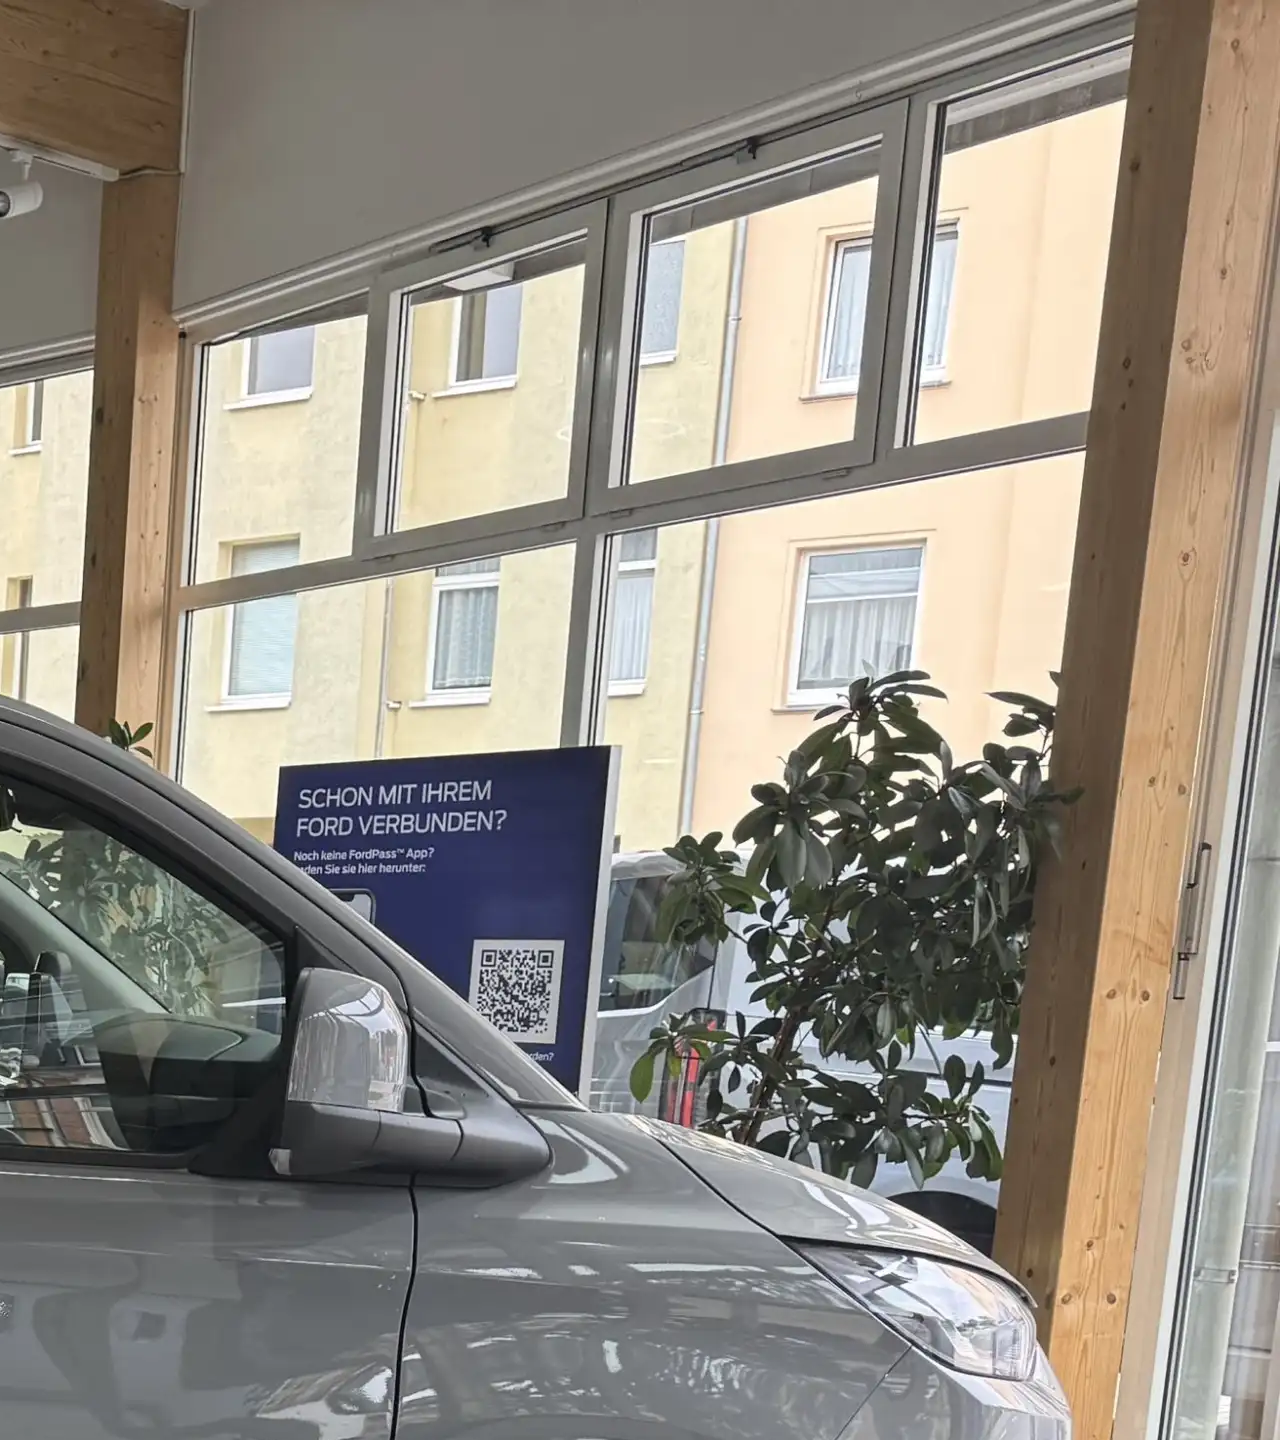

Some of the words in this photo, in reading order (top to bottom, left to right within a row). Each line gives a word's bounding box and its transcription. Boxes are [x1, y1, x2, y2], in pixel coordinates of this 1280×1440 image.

[297, 786, 374, 809] SCHON
[377, 783, 418, 805] MIT
[421, 779, 493, 804] IHREM
[296, 816, 354, 838] FORD
[358, 809, 509, 836] VERBUNDEN?
[293, 851, 320, 861] Noch
[320, 849, 347, 861] keine
[405, 847, 436, 860] App?
[324, 863, 341, 875] Sie
[341, 863, 357, 875] sie
[357, 862, 378, 874] hier
